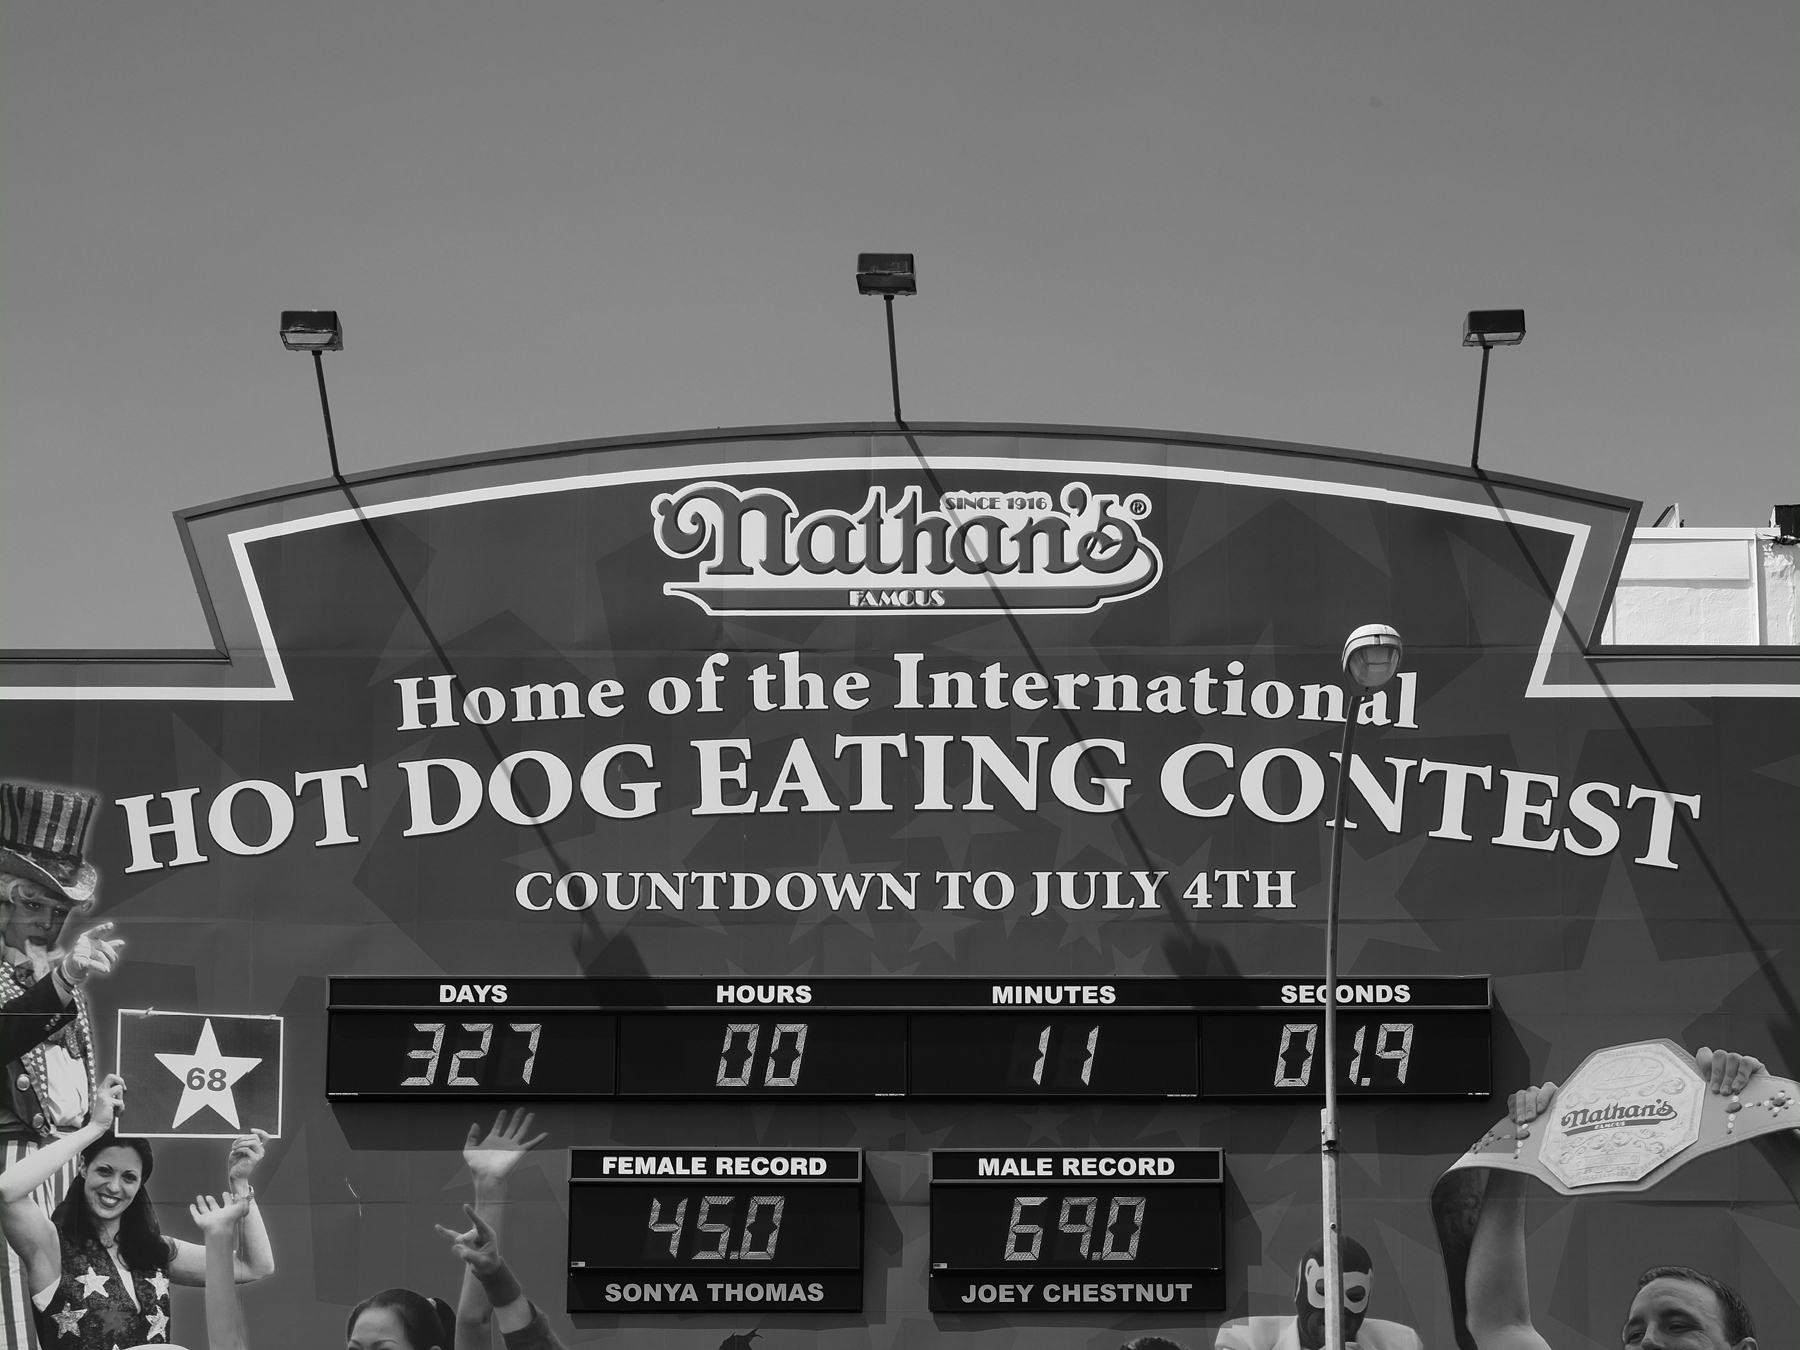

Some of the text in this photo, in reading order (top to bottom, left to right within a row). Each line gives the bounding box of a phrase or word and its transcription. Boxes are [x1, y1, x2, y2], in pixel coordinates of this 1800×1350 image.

[944, 494, 1048, 512] SINCE 1916
[849, 590, 945, 608] FAMOUS
[396, 651, 1419, 731] Home of the International
[115, 730, 1702, 874] HOT DOG EATING CONTEST
[512, 868, 1298, 920] COUNTDOWN TO JULY 4TH
[440, 985, 507, 1002] DAYS
[717, 985, 811, 1003] HOURS
[993, 986, 1116, 1004] MINUTES
[1280, 984, 1412, 1004] SECONDS
[401, 1023, 542, 1086] 327
[716, 1024, 808, 1086] 00
[1033, 1026, 1099, 1085] 11
[184, 1064, 229, 1094] 68
[1561, 1098, 1678, 1128] Nathan's
[603, 1157, 826, 1175] FEMALE RECORD
[979, 1158, 1174, 1175] MALE RECORD
[605, 1283, 823, 1302] SONYA THOMAS
[961, 1284, 1192, 1303] JOEY CHESTNUT
